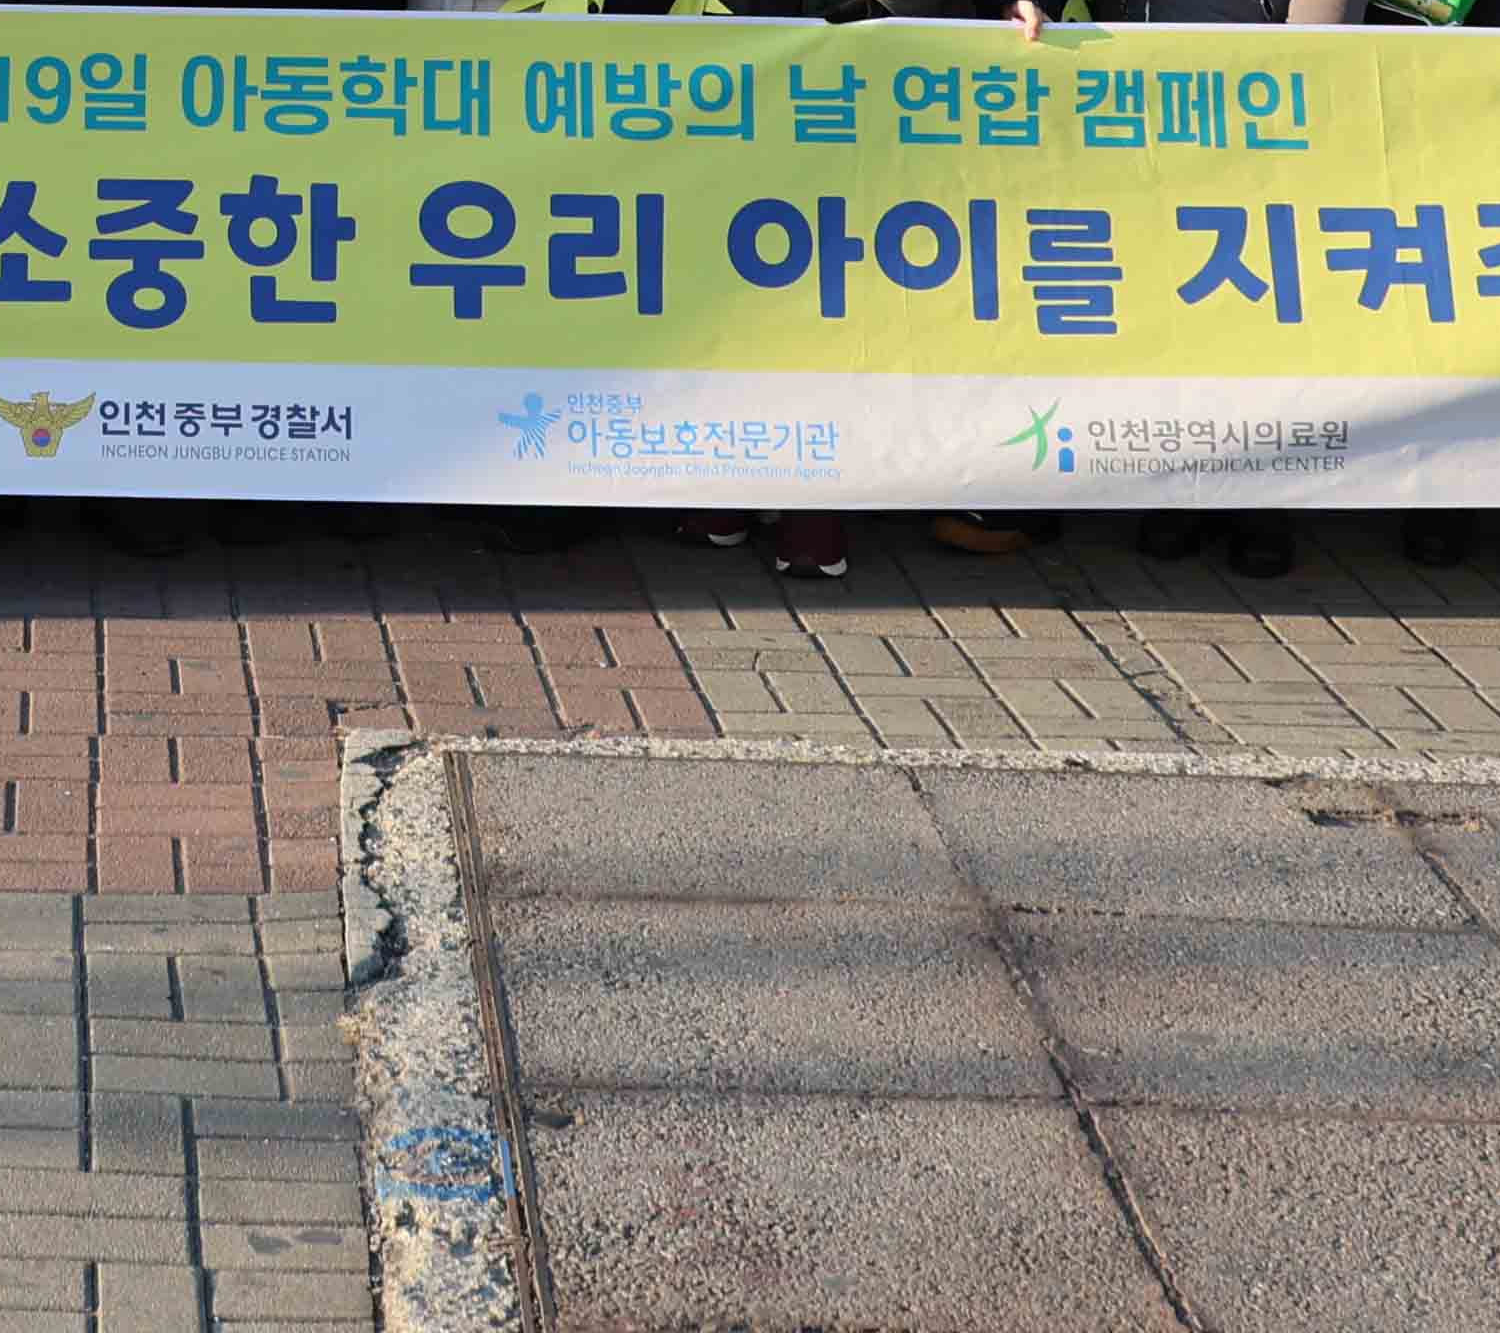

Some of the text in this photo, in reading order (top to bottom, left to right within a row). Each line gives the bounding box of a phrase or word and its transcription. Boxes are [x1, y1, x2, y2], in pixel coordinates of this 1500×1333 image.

[180, 55, 493, 139] 아동학대
[524, 57, 758, 145] 예방의
[788, 61, 866, 145] 날
[893, 64, 1044, 152] 연합
[1073, 65, 1310, 153] 캠페인
[409, 178, 666, 321] 우리
[725, 193, 1122, 337] 아이를
[566, 392, 644, 415] 인천중부
[101, 444, 351, 463] INCHEON JUNGBU POLICE STATION
[567, 418, 841, 462] 아동보호전문기관
[1087, 418, 1349, 455] 인천광역시의료원
[1089, 455, 1345, 475] INCHEON MEDICAL CENTER
